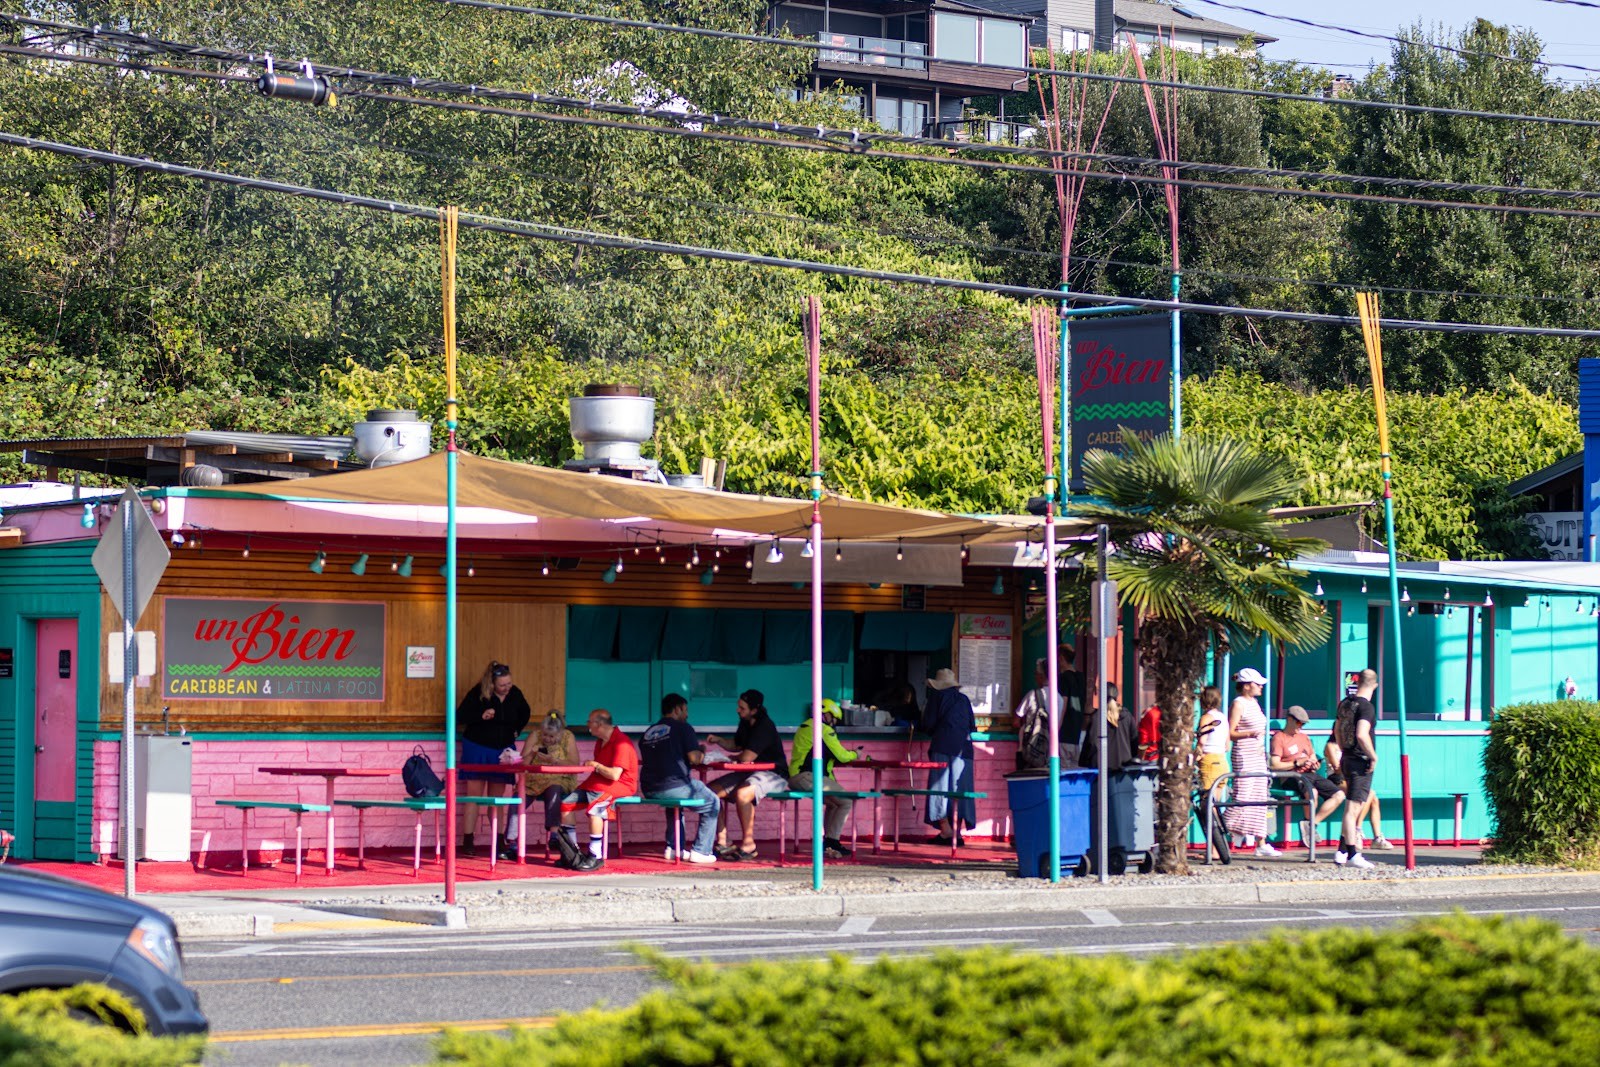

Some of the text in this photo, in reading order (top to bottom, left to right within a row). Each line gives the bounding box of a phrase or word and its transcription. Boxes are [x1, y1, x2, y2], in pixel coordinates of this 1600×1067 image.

[1074, 340, 1166, 397] un Bien
[1087, 429, 1155, 445] CARIBAN
[194, 602, 359, 673] un Bien
[170, 678, 377, 696] CARIBBEAN & LATINA FOOD
